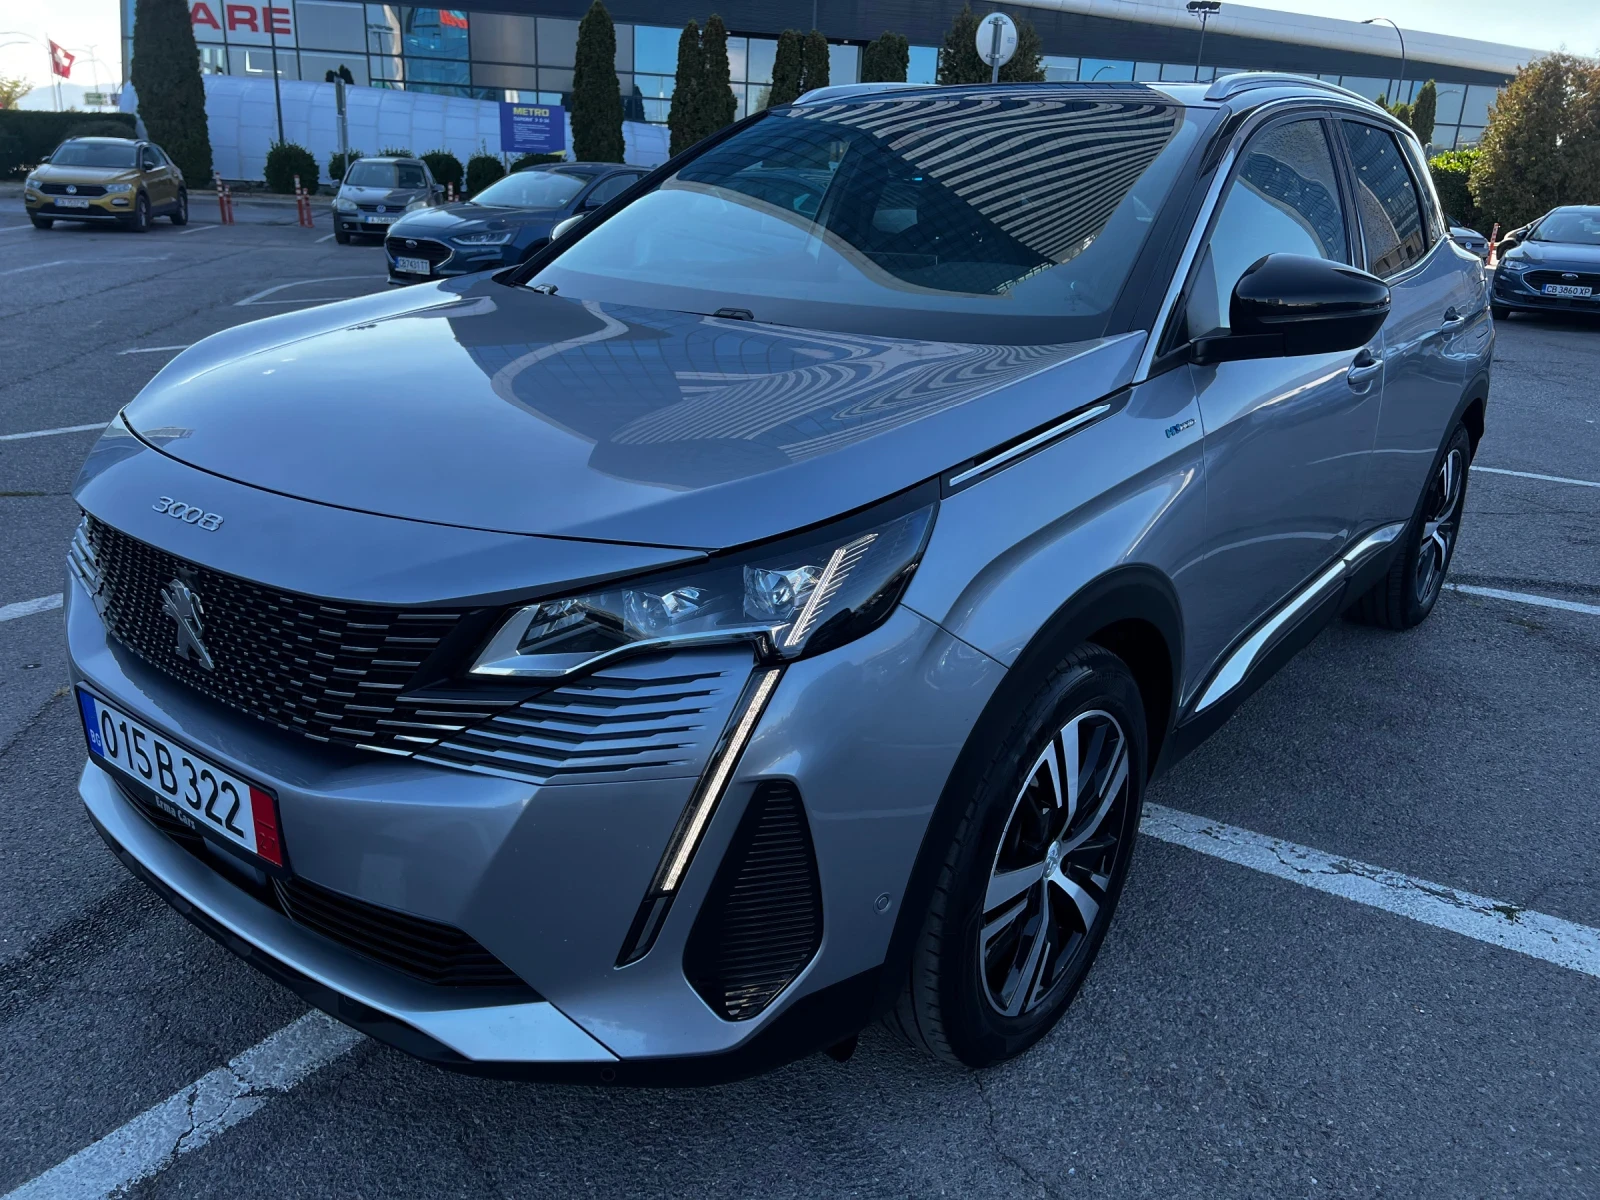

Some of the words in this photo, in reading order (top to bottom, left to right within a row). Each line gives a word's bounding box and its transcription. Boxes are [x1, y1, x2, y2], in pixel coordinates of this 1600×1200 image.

[191, 2, 291, 34] ARE
[513, 107, 549, 117] METRO
[152, 496, 224, 532] 3008
[90, 728, 101, 746] BG
[178, 809, 196, 830] Cars
